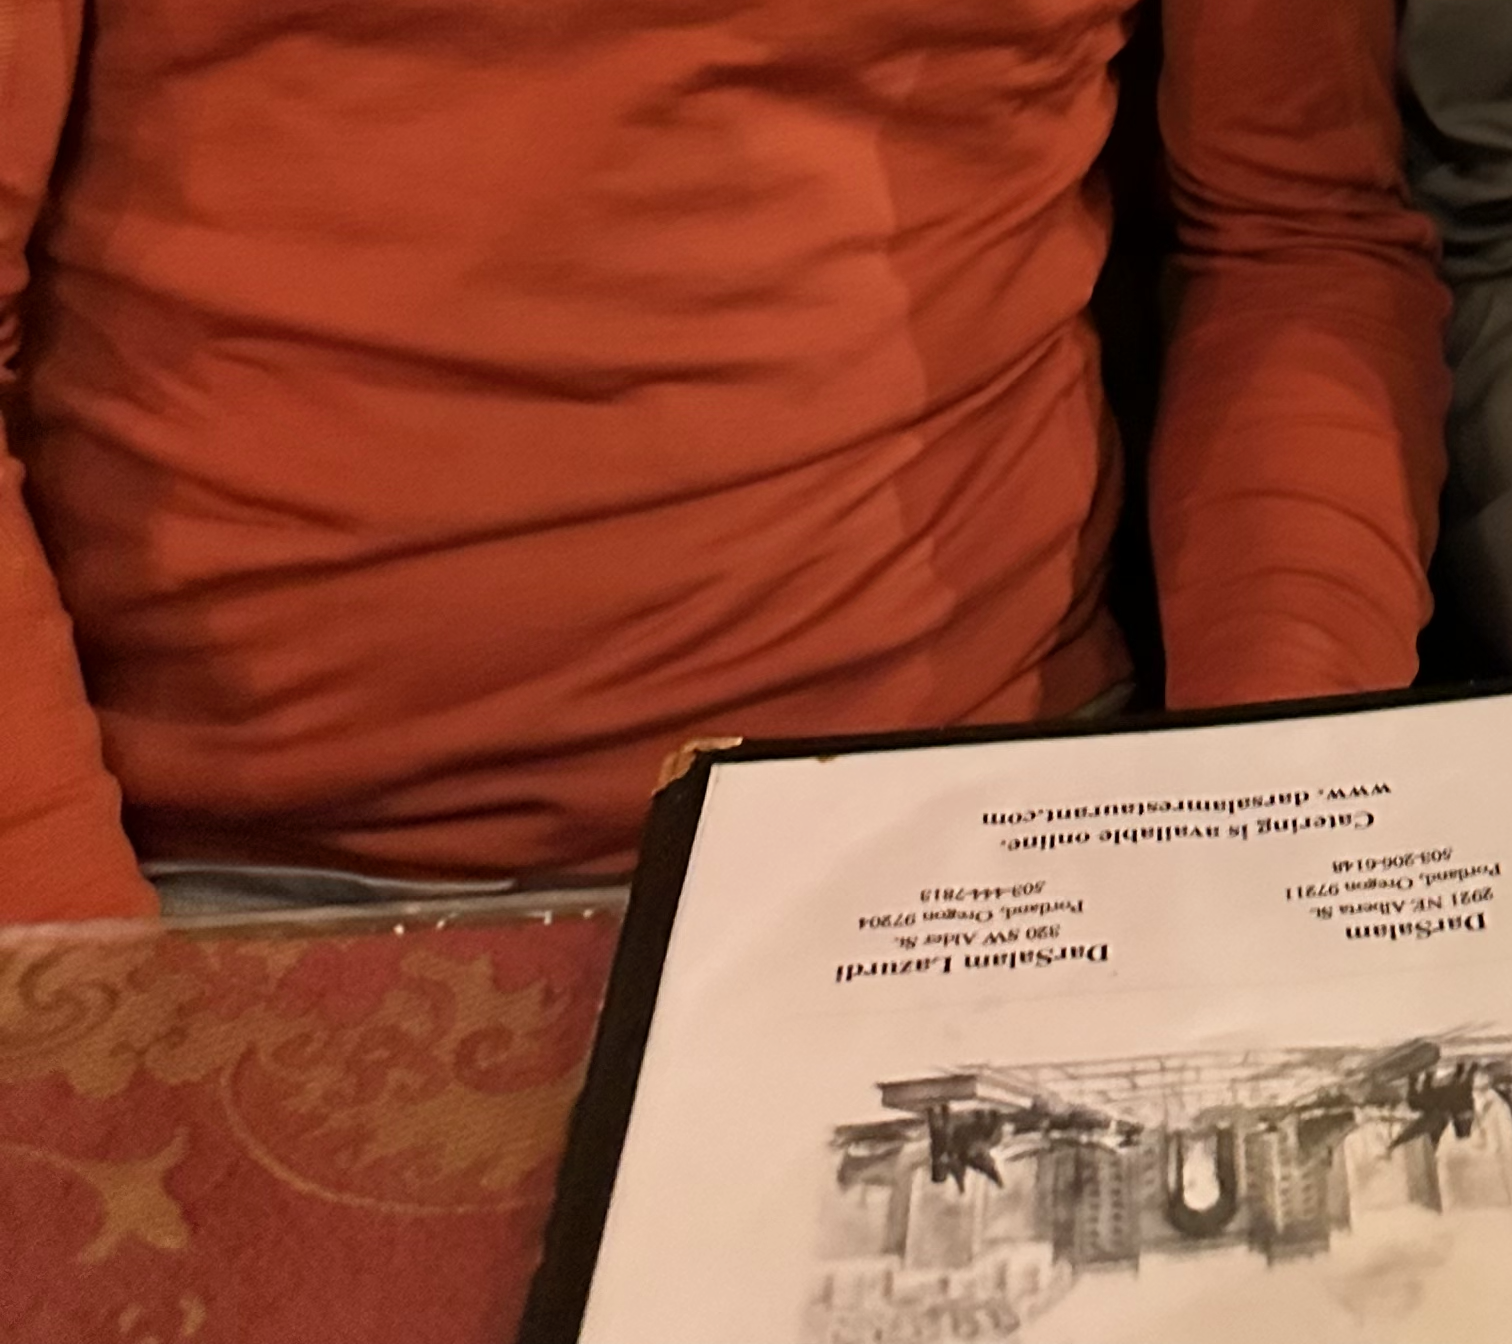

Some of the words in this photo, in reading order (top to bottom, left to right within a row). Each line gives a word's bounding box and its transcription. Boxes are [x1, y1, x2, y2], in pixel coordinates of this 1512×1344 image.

[1318, 781, 1392, 801] www.
[982, 789, 1310, 826] darsalamrestaurant.com
[1229, 823, 1249, 841] is
[1256, 810, 1375, 836] Catering
[999, 829, 1092, 852] online.
[1098, 825, 1220, 845] available
[1344, 876, 1414, 893] Oregon
[1418, 862, 1502, 887] Portland,
[1284, 882, 1340, 902] 97211
[1451, 886, 1495, 906] 2921
[1002, 899, 1085, 920] Portland,
[1340, 900, 1403, 917] Alberta
[1412, 895, 1442, 911] NE
[858, 912, 917, 930] 97204
[922, 910, 994, 925] Oregon
[1345, 911, 1487, 941] DarSalam
[923, 931, 978, 947] Alder
[984, 928, 1019, 943] SW
[1026, 924, 1061, 940] 320
[963, 943, 1109, 970] DarSalam
[834, 954, 952, 984] Lazurdi
